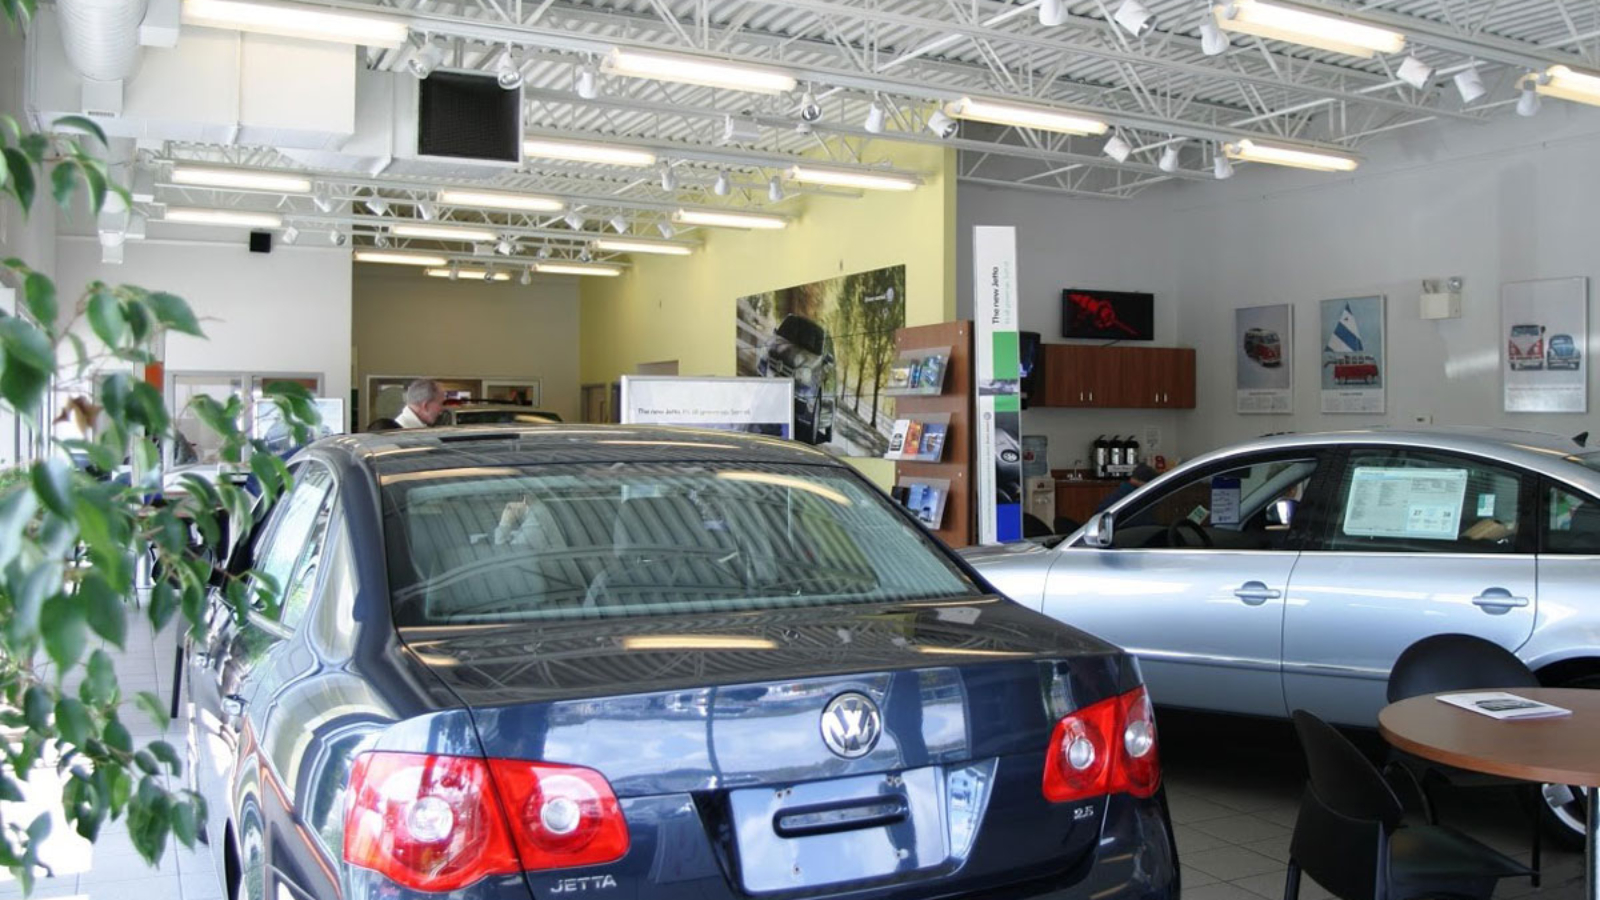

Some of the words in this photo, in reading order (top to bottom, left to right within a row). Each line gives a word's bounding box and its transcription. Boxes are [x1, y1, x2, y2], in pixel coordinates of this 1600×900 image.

[991, 267, 999, 286] Jetta
[991, 308, 999, 324] The
[550, 874, 617, 893] JETTA
